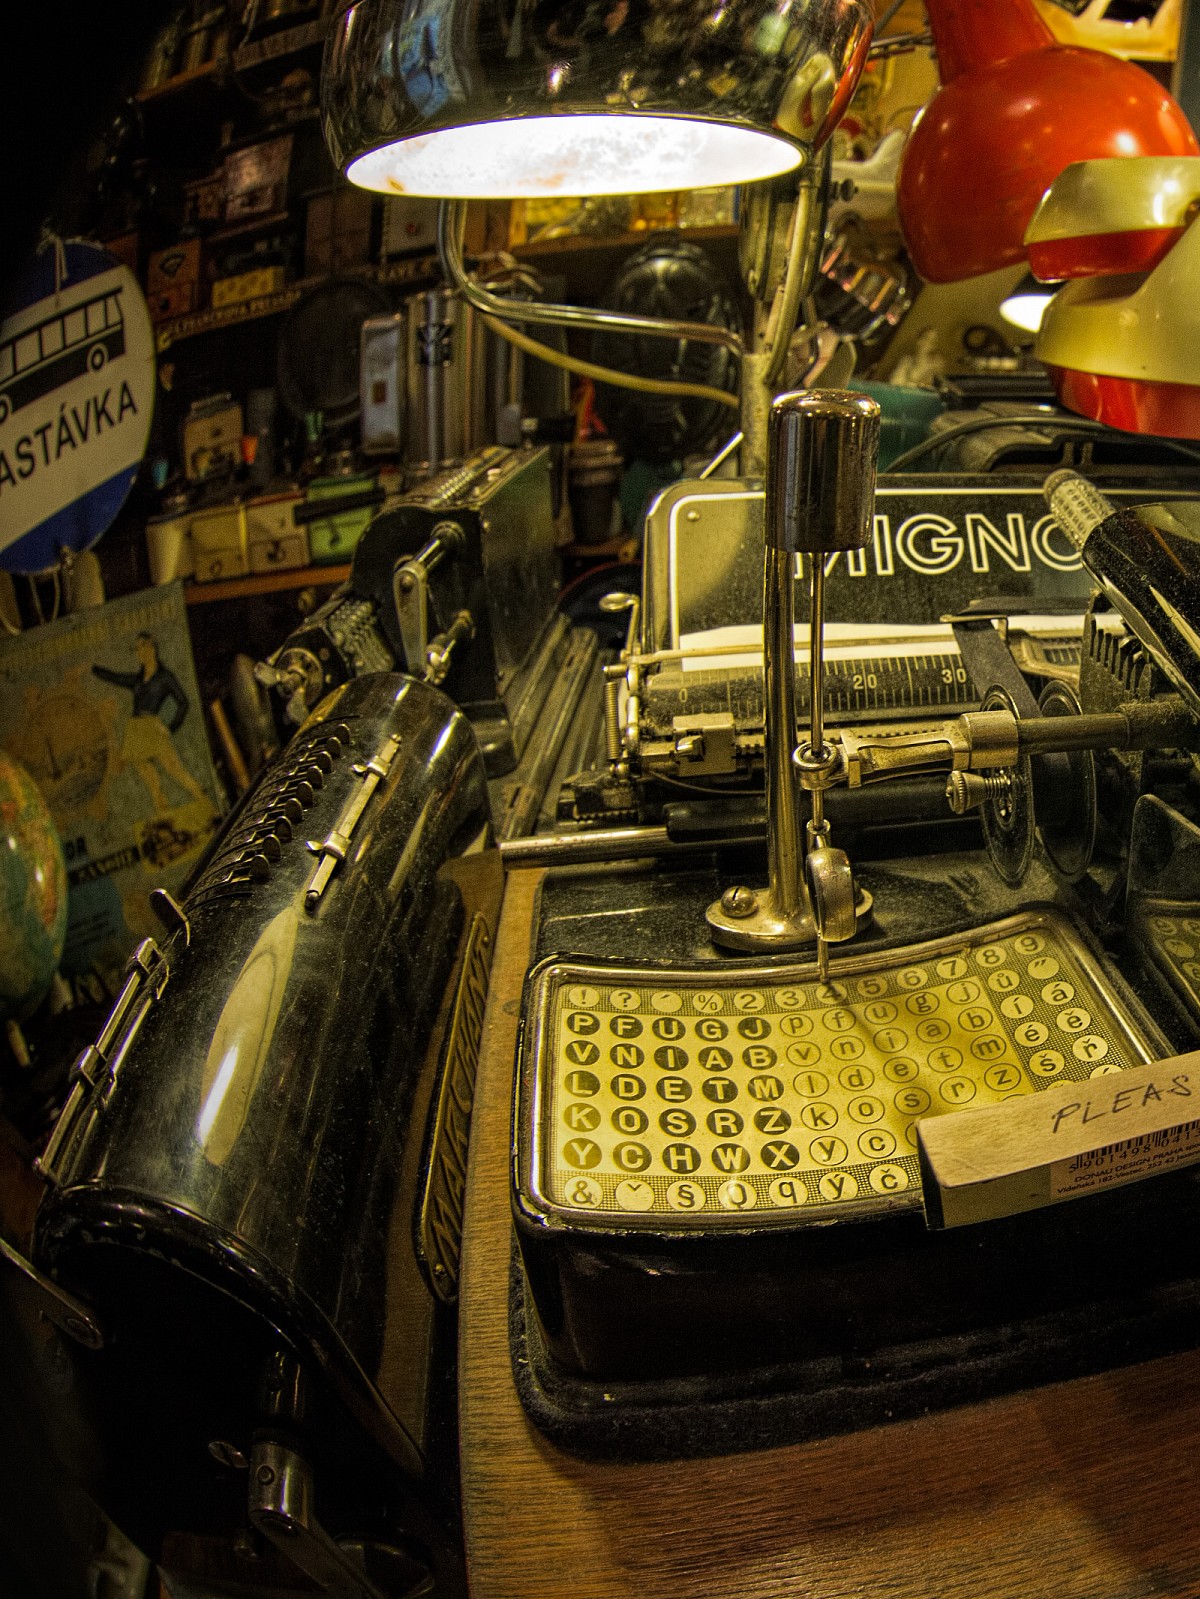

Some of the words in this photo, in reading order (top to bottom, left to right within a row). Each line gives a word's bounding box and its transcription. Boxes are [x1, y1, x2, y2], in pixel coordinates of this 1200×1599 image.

[678, 687, 689, 703] 0
[852, 673, 878, 690] 20
[941, 667, 967, 683] 30
[573, 1013, 594, 1033] P
[618, 1017, 636, 1037] F
[658, 1020, 678, 1041] U
[703, 1021, 723, 1041] G
[745, 1020, 763, 1038] J
[789, 1016, 803, 1034] p
[834, 1011, 845, 1030] f
[873, 1004, 888, 1019] u
[915, 994, 930, 1014] g
[997, 971, 1011, 989] ů
[619, 991, 632, 1008] ?
[698, 994, 718, 1011] %
[739, 993, 755, 1010] 2
[784, 990, 797, 1007] 3
[825, 984, 841, 1000] 4
[864, 979, 881, 995] 5
[903, 970, 919, 987] 6
[943, 960, 957, 976] 7
[984, 949, 999, 966] 8
[1020, 936, 1039, 952] 9
[571, 1044, 593, 1063] V
[618, 1047, 638, 1066] N
[705, 1048, 728, 1069] A
[751, 1048, 770, 1067] B
[796, 1046, 810, 1061] v
[840, 1040, 855, 1054] n
[926, 1023, 942, 1038] a
[967, 1009, 984, 1029] b
[1012, 998, 1022, 1016] í
[1051, 984, 1067, 1002] á
[572, 1073, 594, 1093] L
[619, 1077, 639, 1097] D
[666, 1080, 685, 1100] E
[709, 1080, 730, 1100] T
[752, 1077, 778, 1098] M
[848, 1068, 864, 1088] d
[893, 1061, 909, 1077] e
[938, 1052, 953, 1069] t
[977, 1039, 1001, 1055] m
[1024, 1025, 1040, 1042] é
[1066, 1009, 1082, 1028] ě
[571, 1107, 593, 1129] K
[619, 1110, 641, 1131] O
[667, 1113, 688, 1134] S
[714, 1113, 738, 1134] R
[761, 1109, 784, 1130] Z
[810, 1106, 829, 1127] k
[859, 1102, 875, 1118] o
[904, 1091, 920, 1109] s
[951, 1082, 965, 1098] r
[994, 1071, 1011, 1084] z
[1039, 1052, 1056, 1072] š
[1083, 1039, 1097, 1057] ř
[572, 1142, 593, 1165] Y
[620, 1146, 643, 1169] C
[670, 1148, 694, 1170] H
[715, 1148, 742, 1171] W
[767, 1146, 795, 1168] X
[818, 1140, 836, 1161] y
[868, 1134, 886, 1152] c
[1075, 1168, 1112, 1183] DONAU
[1115, 1156, 1151, 1172] DESIGN
[1153, 1147, 1183, 1160] PRAHA
[572, 1180, 595, 1204] &
[677, 1184, 695, 1209] §
[779, 1181, 797, 1205] q
[828, 1173, 845, 1199] ý
[880, 1168, 898, 1189] č
